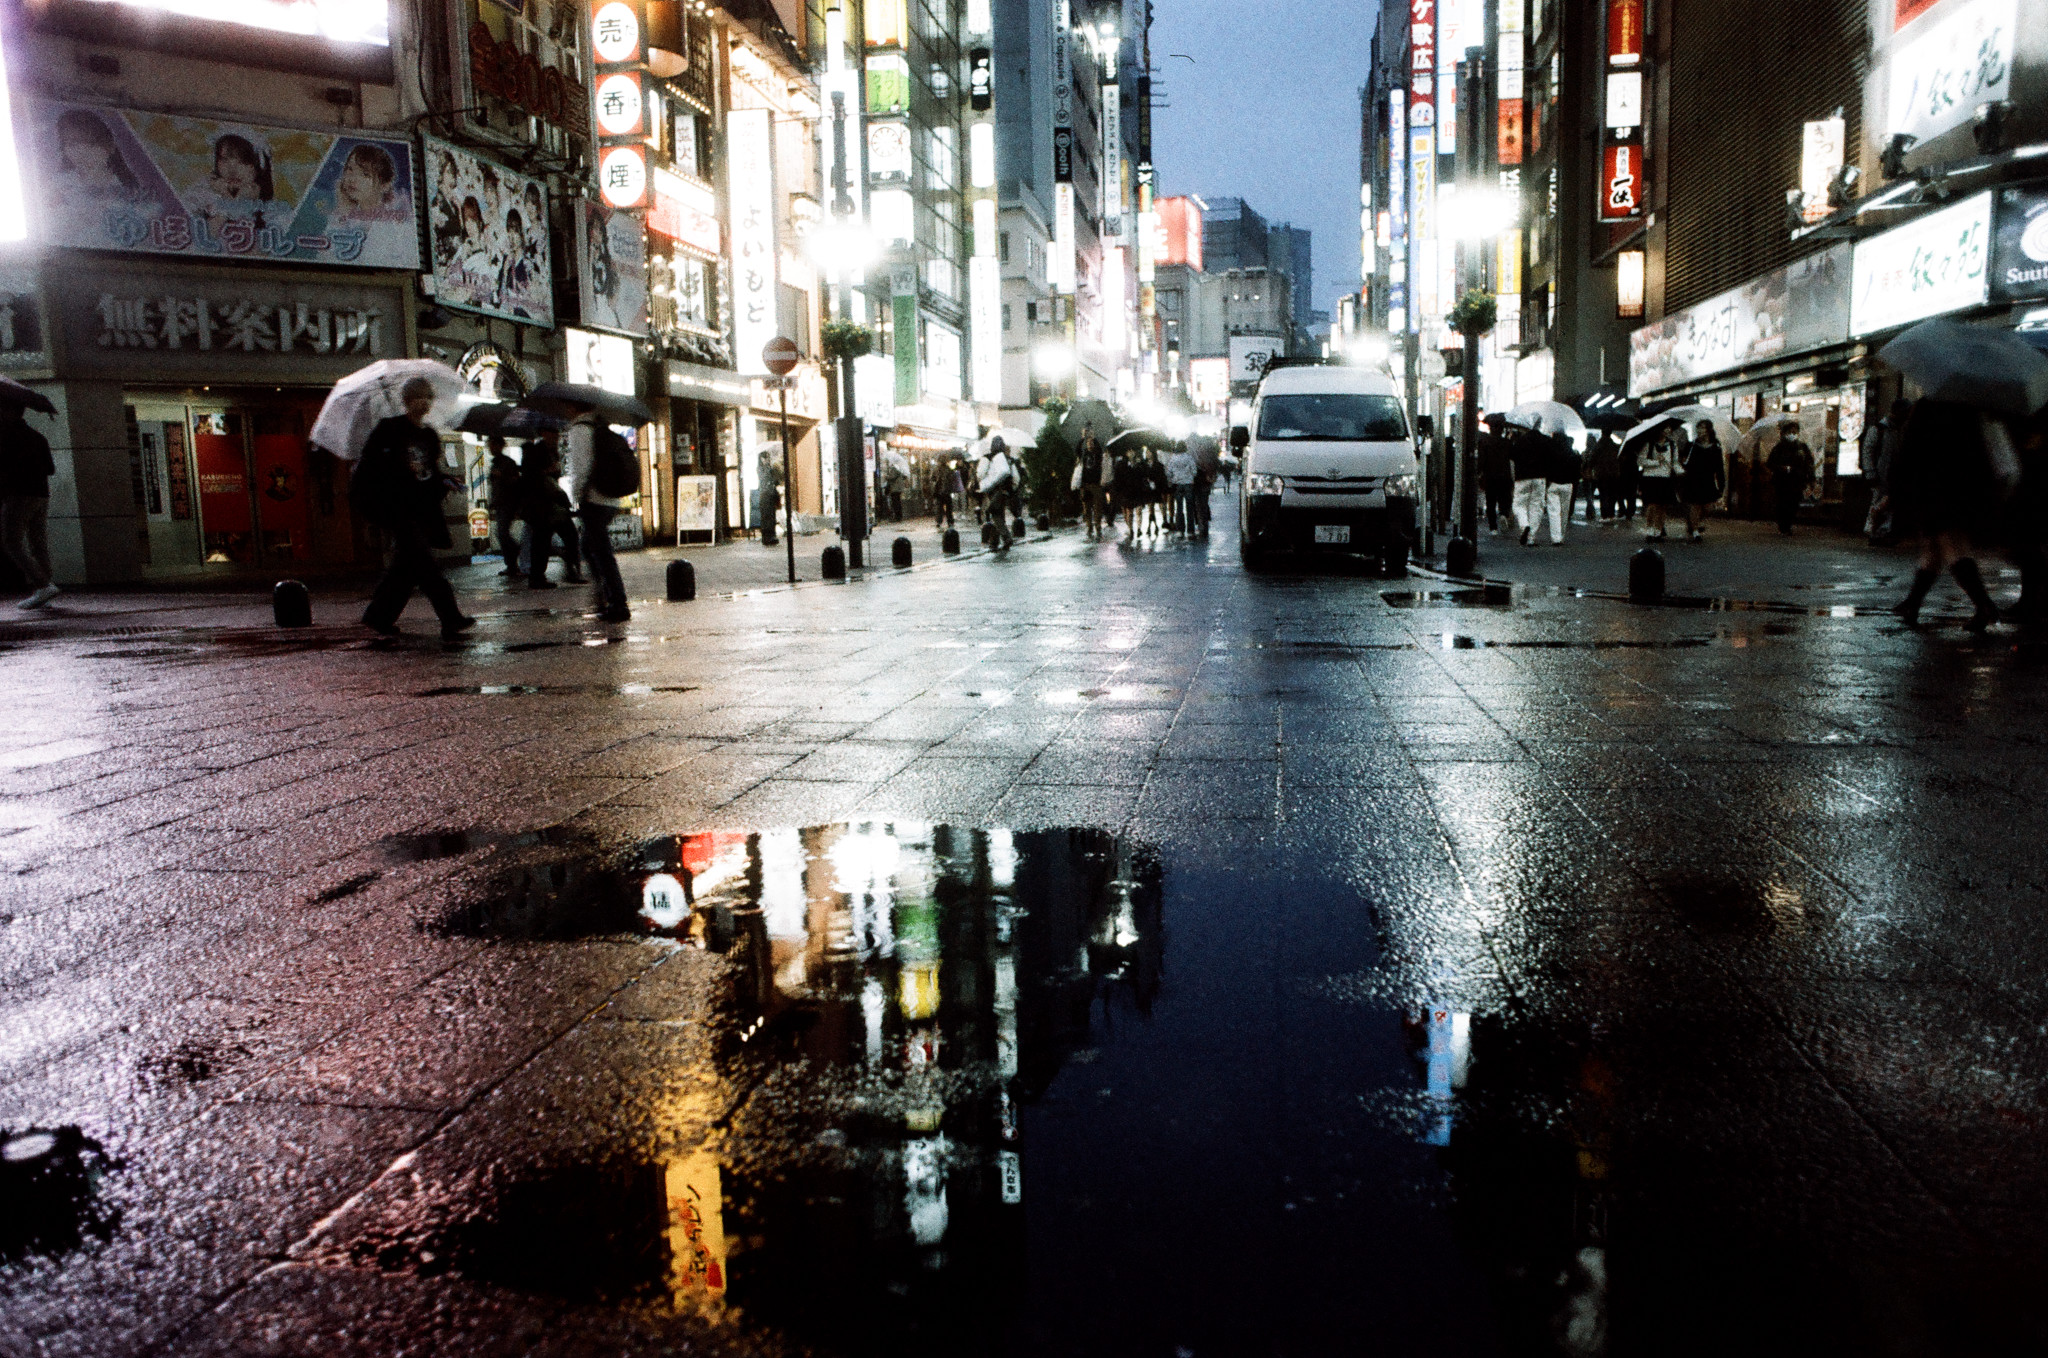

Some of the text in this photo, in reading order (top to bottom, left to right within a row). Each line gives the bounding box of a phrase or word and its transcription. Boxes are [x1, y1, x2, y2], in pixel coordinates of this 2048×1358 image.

[1056, 38, 1069, 80] Capsule
[1612, 177, 1633, 207] 一休
[102, 207, 367, 261] ゆほしグループ
[98, 293, 383, 355] 無料案内所
